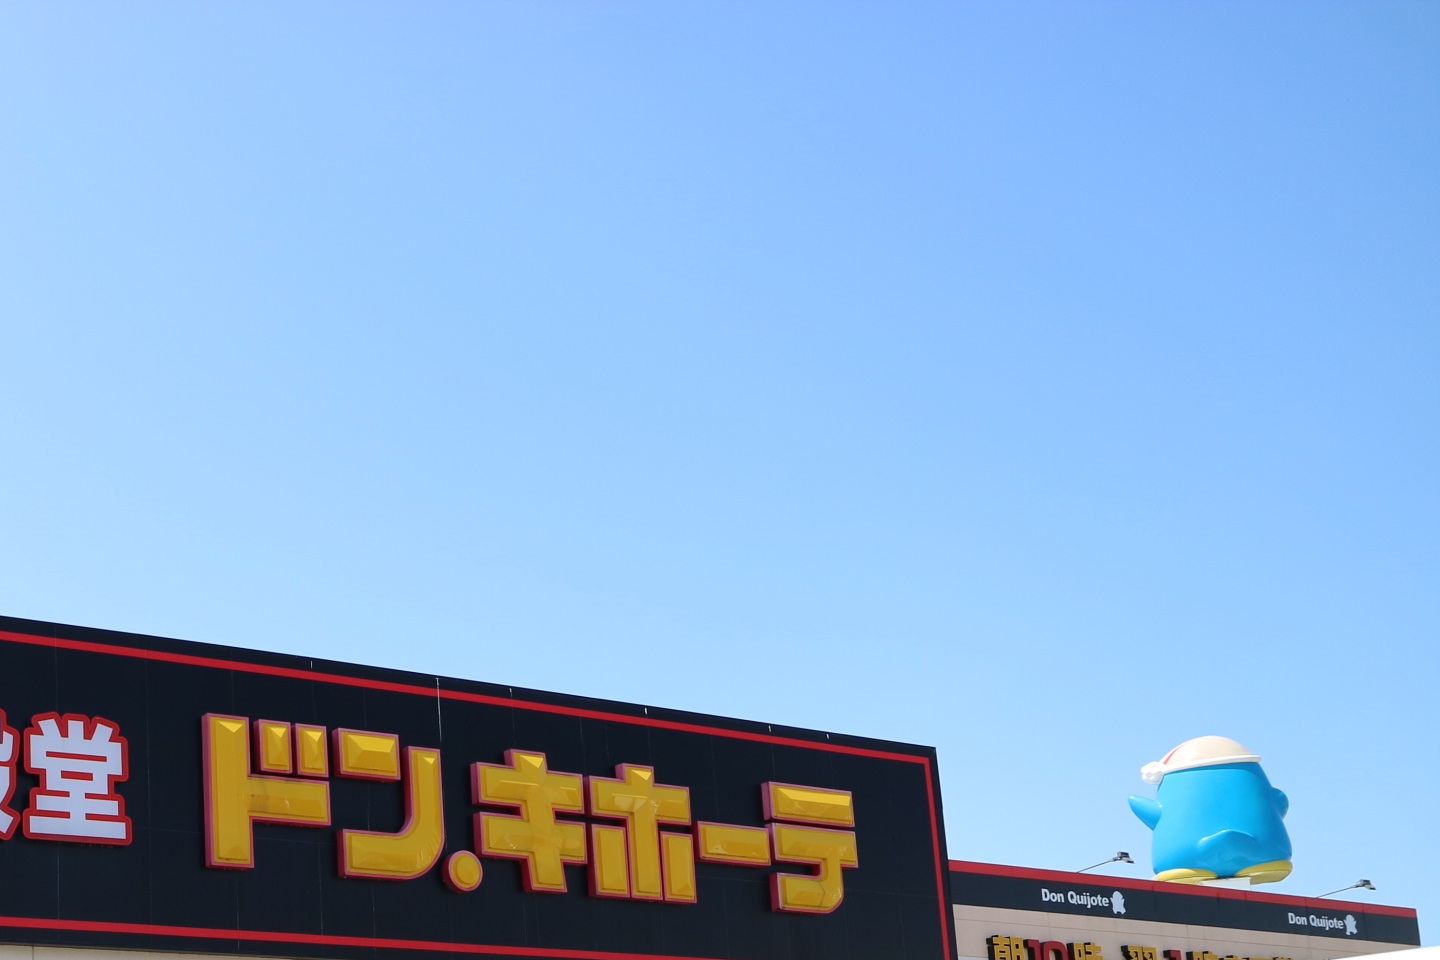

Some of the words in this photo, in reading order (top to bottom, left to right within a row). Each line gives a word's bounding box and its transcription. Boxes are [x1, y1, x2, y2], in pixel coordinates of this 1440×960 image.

[1041, 888, 1065, 904] Don
[1068, 891, 1110, 909] Quijote
[1288, 912, 1308, 927] Don
[1309, 915, 1344, 931] Quijote
